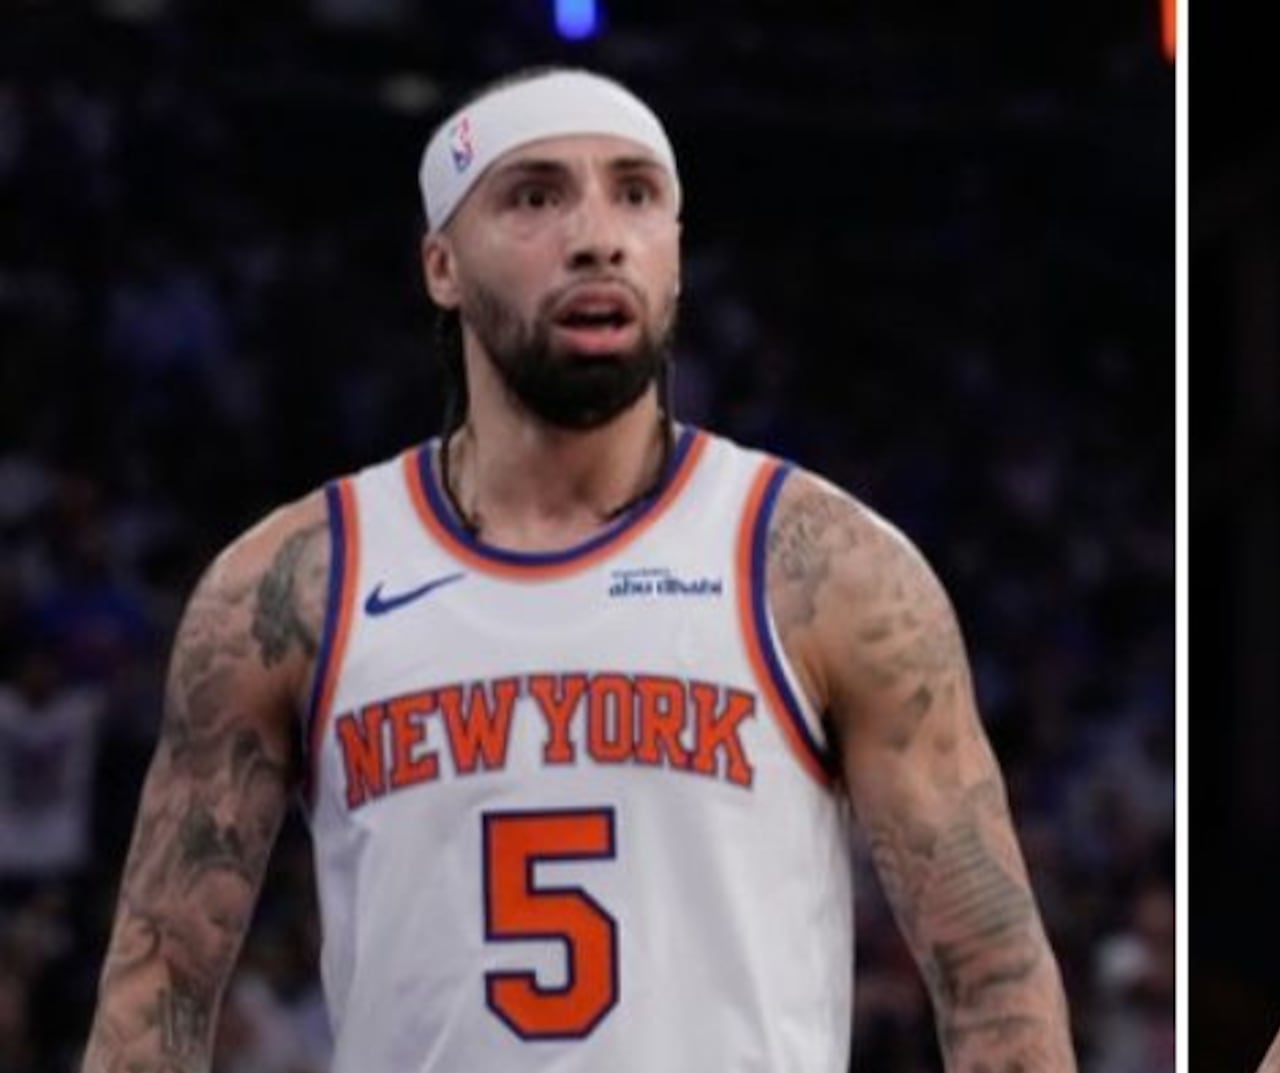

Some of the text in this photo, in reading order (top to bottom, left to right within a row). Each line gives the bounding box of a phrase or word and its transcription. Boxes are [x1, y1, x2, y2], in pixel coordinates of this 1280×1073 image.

[335, 673, 757, 811] NEW YORK
[481, 806, 620, 1041] 5
